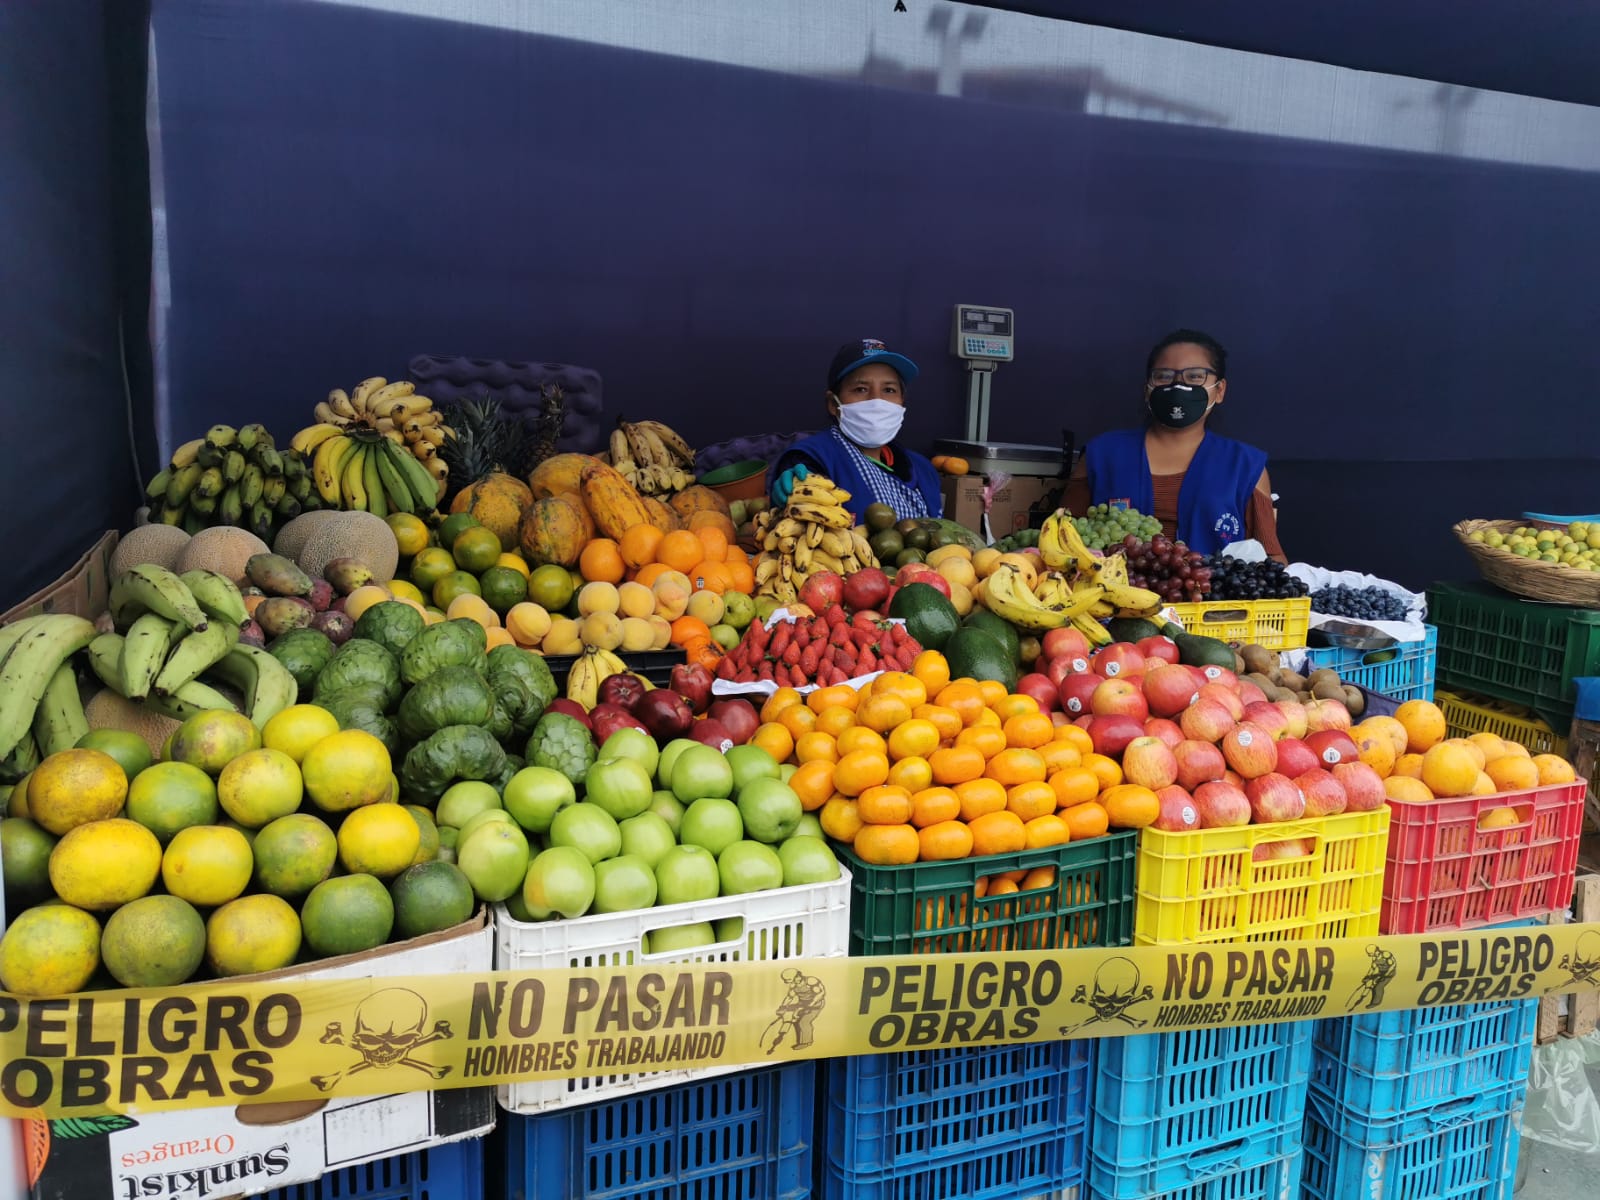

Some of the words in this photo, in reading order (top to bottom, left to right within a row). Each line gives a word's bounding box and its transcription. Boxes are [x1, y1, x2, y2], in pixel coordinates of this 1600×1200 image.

[1162, 951, 1213, 1001] NO
[1222, 947, 1335, 997] PASAR
[1416, 933, 1554, 981] PELIGRO
[468, 978, 545, 1040] NO
[562, 971, 733, 1034] PASAR
[859, 959, 1062, 1015] PELIGRO
[1153, 1002, 1231, 1027] HOMBRES
[1231, 995, 1327, 1022] TRABAJANDO
[1417, 973, 1536, 1006] OBRAS
[868, 1007, 1040, 1048] OBRAS
[464, 1041, 577, 1077] HOMBRES
[587, 1030, 726, 1068] TRABAJANDO
[1, 1051, 274, 1109] OBRAS
[121, 1134, 235, 1168] Oranges
[121, 1142, 290, 1200] Sunkist
